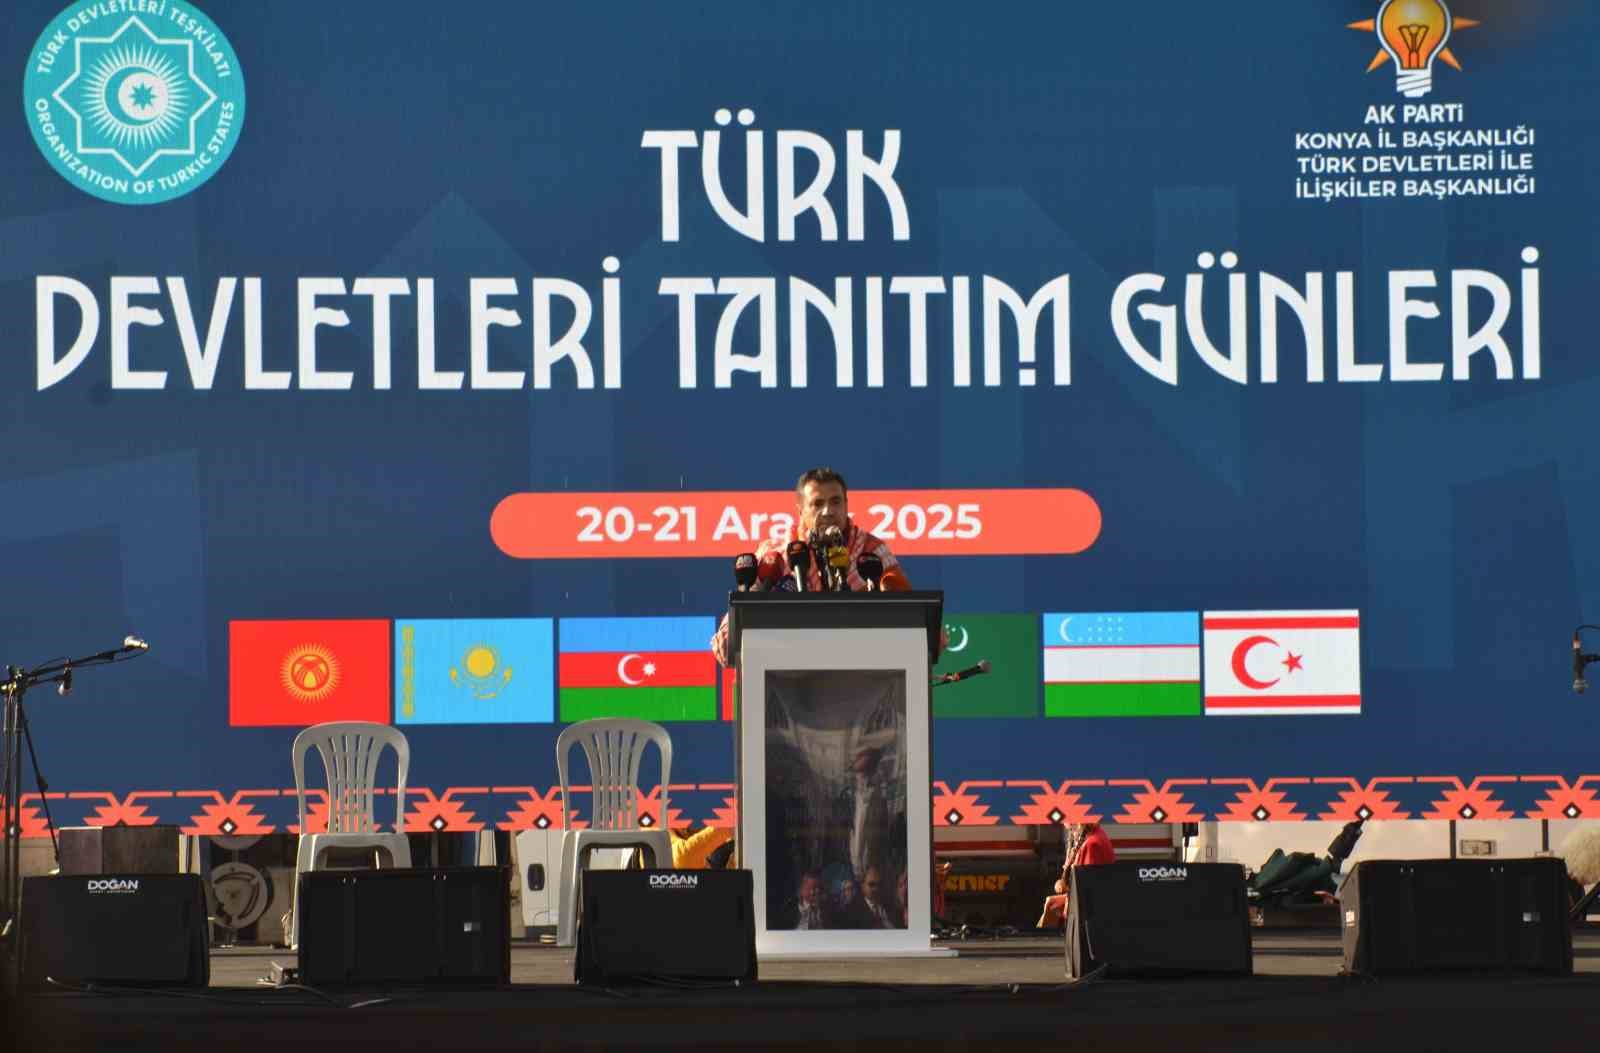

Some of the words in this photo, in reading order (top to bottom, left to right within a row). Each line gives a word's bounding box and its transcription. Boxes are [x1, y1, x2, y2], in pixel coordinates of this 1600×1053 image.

[37, 31, 70, 74] TÜRK
[169, 7, 232, 78] TEŞKİLATI
[1364, 105, 1396, 124] AK
[35, 98, 129, 193] ORGANIZATION
[132, 180, 155, 194] OF
[157, 154, 212, 191] TURKIC
[207, 101, 235, 156] STATES
[1295, 132, 1372, 150] KONYA
[1378, 127, 1397, 149] İL
[1402, 125, 1535, 152] BAŞKANLIĞI
[640, 108, 910, 243] TÜRK
[1297, 154, 1356, 174] TÜRK
[1362, 150, 1494, 173] DEVLETLERİ
[1500, 150, 1534, 170] İLE
[1295, 177, 1397, 202] İLİŞKİLER
[1403, 174, 1536, 200] BAŞKANLIĞI
[36, 256, 622, 391] DEVLETLERİ
[658, 273, 1071, 389] TANITIM
[1110, 246, 1541, 386] GÜNLERİ
[575, 505, 698, 542] 20-21
[868, 503, 983, 541] 2025
